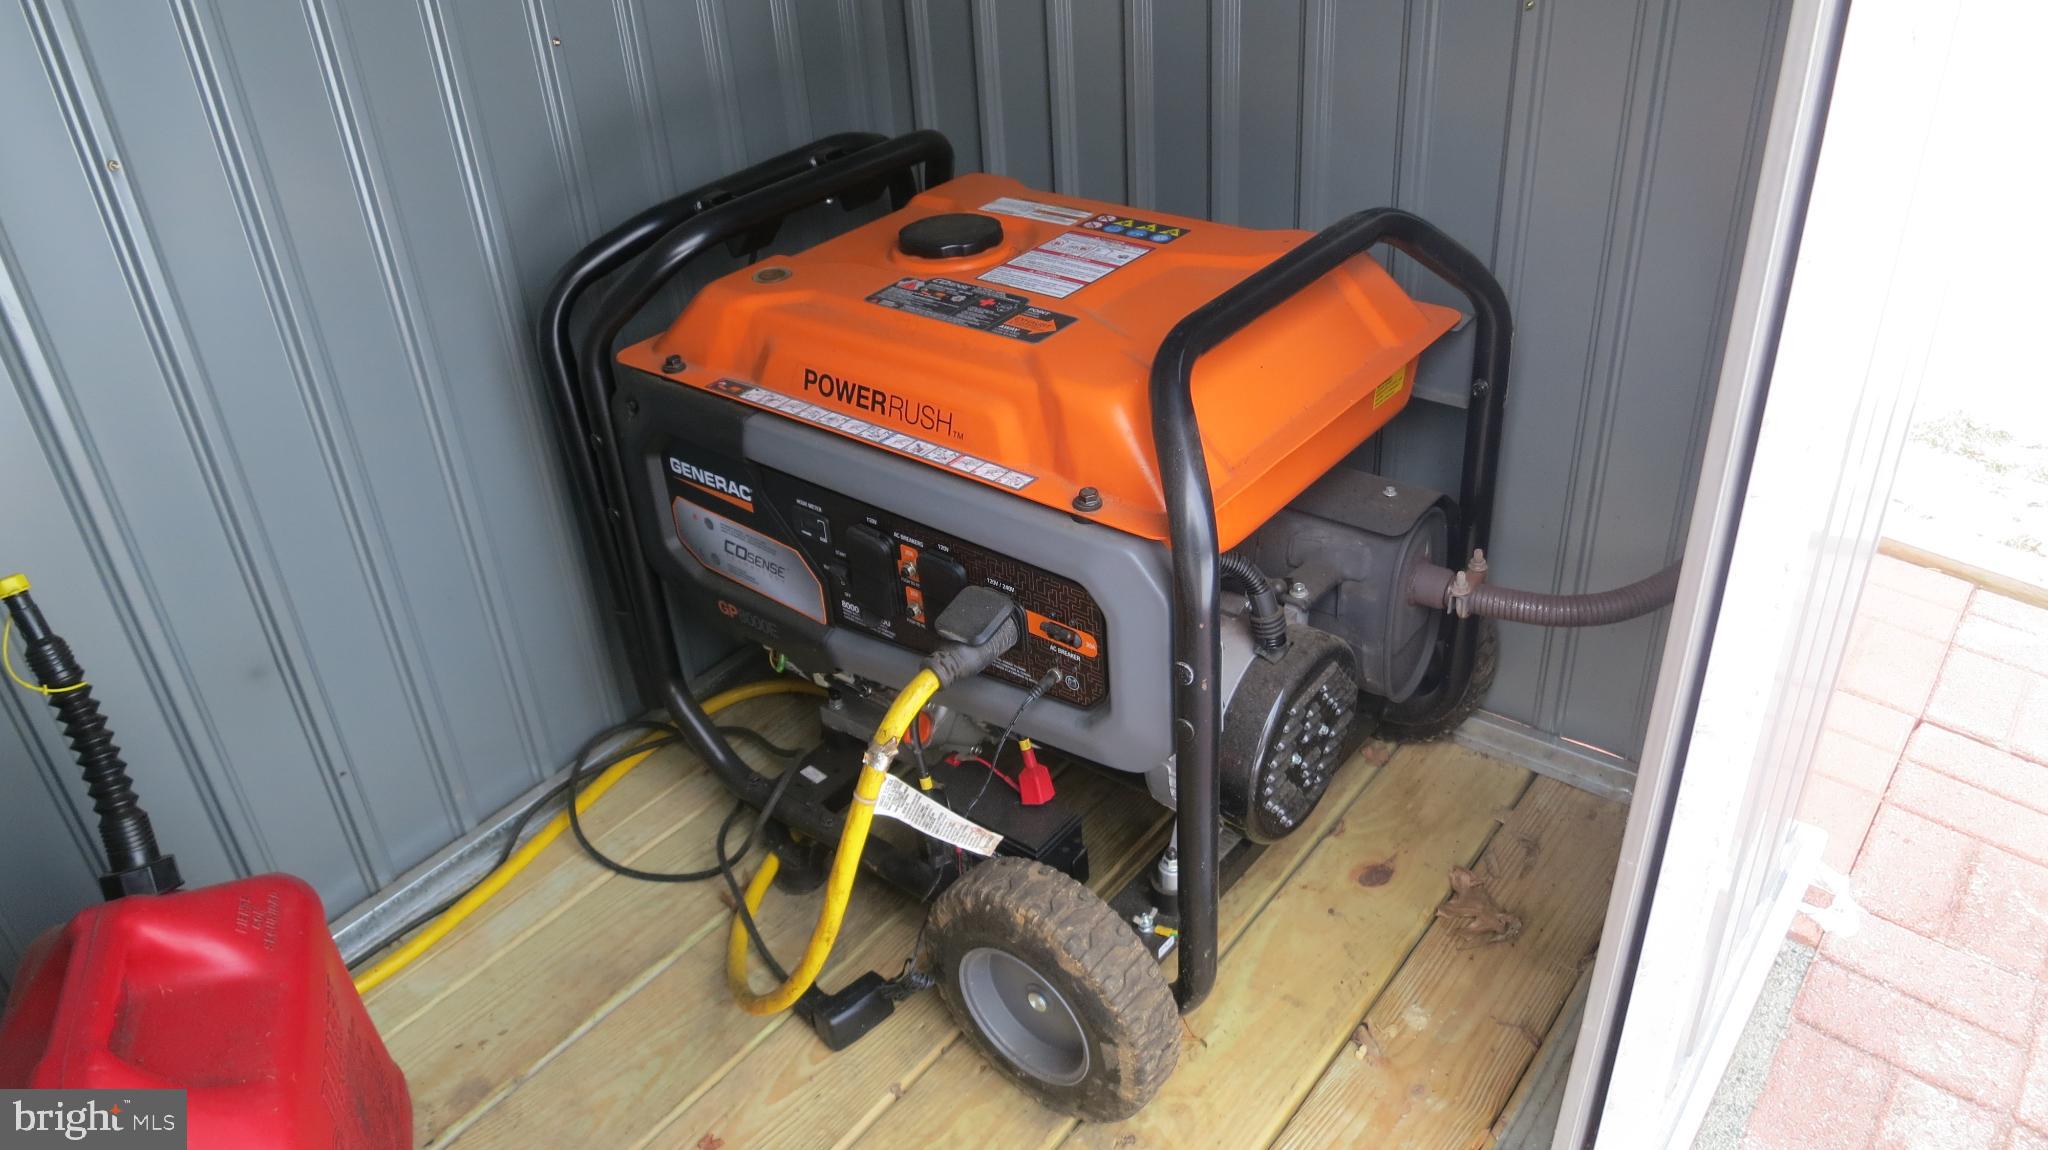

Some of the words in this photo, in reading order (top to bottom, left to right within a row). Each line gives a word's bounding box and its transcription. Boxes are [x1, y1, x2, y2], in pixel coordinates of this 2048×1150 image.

[804, 368, 952, 436] POWERRUSH
[669, 457, 752, 501] GENERAC
[938, 543, 949, 553] 120V
[987, 577, 999, 587] 120V
[841, 600, 860, 614] 8000
[1057, 647, 1081, 661] BREAKER
